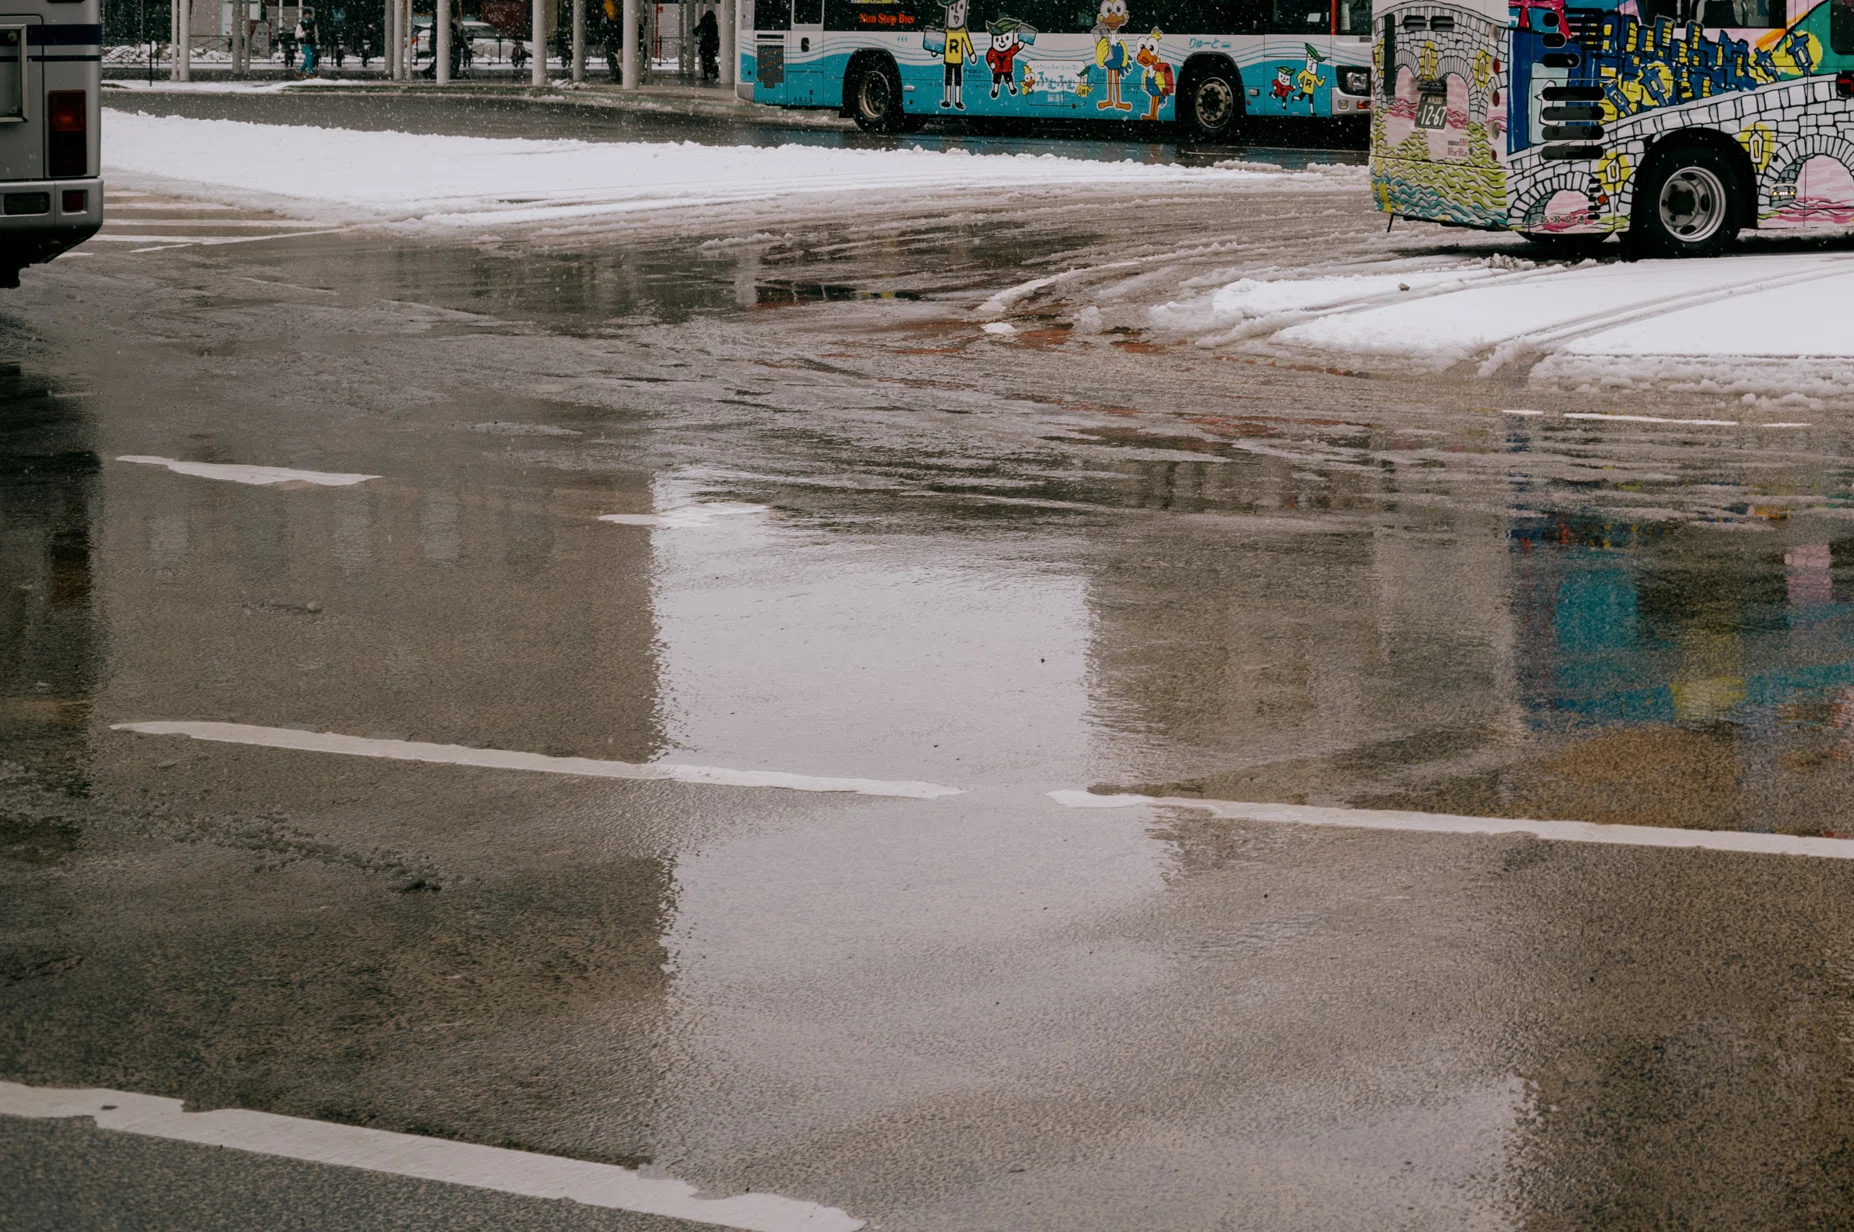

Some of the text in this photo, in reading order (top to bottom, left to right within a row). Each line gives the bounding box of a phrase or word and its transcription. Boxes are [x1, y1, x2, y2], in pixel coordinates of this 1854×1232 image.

[859, 13, 915, 26] Non Step Bus
[949, 39, 959, 54] R
[1305, 78, 1312, 89] R
